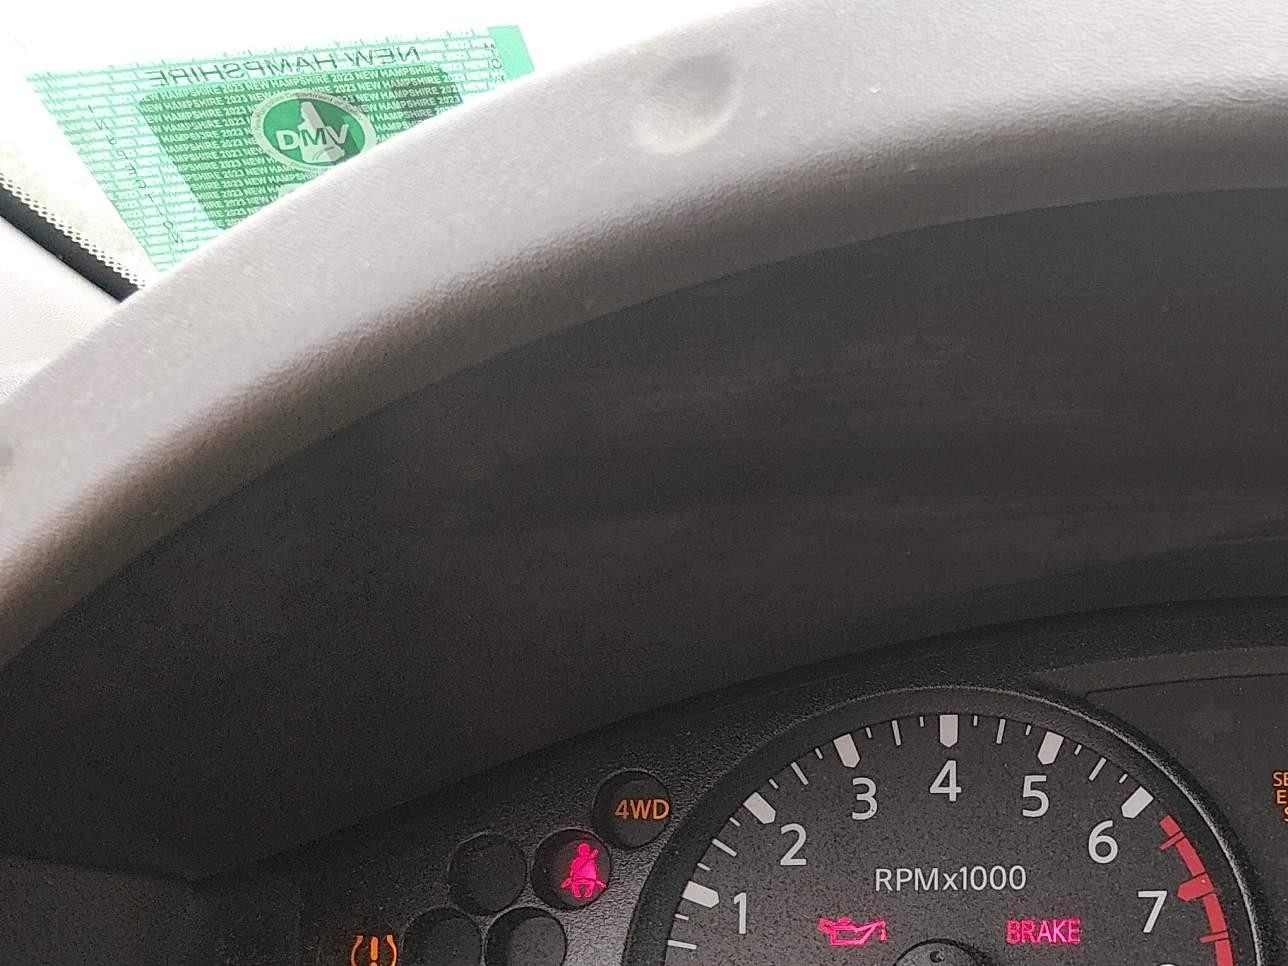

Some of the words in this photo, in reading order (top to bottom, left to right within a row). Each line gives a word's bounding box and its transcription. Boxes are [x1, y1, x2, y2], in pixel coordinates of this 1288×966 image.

[223, 84, 245, 93] 2023
[246, 80, 270, 91] NEW
[331, 72, 354, 82] 2023
[355, 70, 379, 80] NEW
[380, 64, 440, 77] HAMPSHIRE
[333, 84, 356, 93] 2023
[357, 81, 380, 91] NEW
[382, 75, 442, 89] HAMPSHIRE
[163, 97, 224, 111] HAMPSHIRE
[225, 95, 248, 104] 2023
[355, 93, 379, 102] NEW
[380, 87, 440, 100] HAMPSHIRE
[381, 97, 438, 111] HAMPSHIRE
[437, 95, 460, 105] 2023
[163, 109, 223, 122] HAMPSHIRE
[224, 107, 246, 116] 2023
[223, 117, 246, 127] 2023
[221, 128, 244, 137] 2023
[276, 124, 349, 150] DMV
[930, 761, 961, 801] 4
[615, 800, 670, 820] 4WD
[852, 778, 877, 820] 3
[1023, 776, 1049, 818] 5
[781, 824, 807, 866] 2
[1089, 821, 1117, 863] 6
[875, 865, 1027, 892] RPMx1000
[734, 893, 747, 935] 1
[1138, 890, 1167, 933] 7
[1006, 918, 1081, 944] BRAKE
